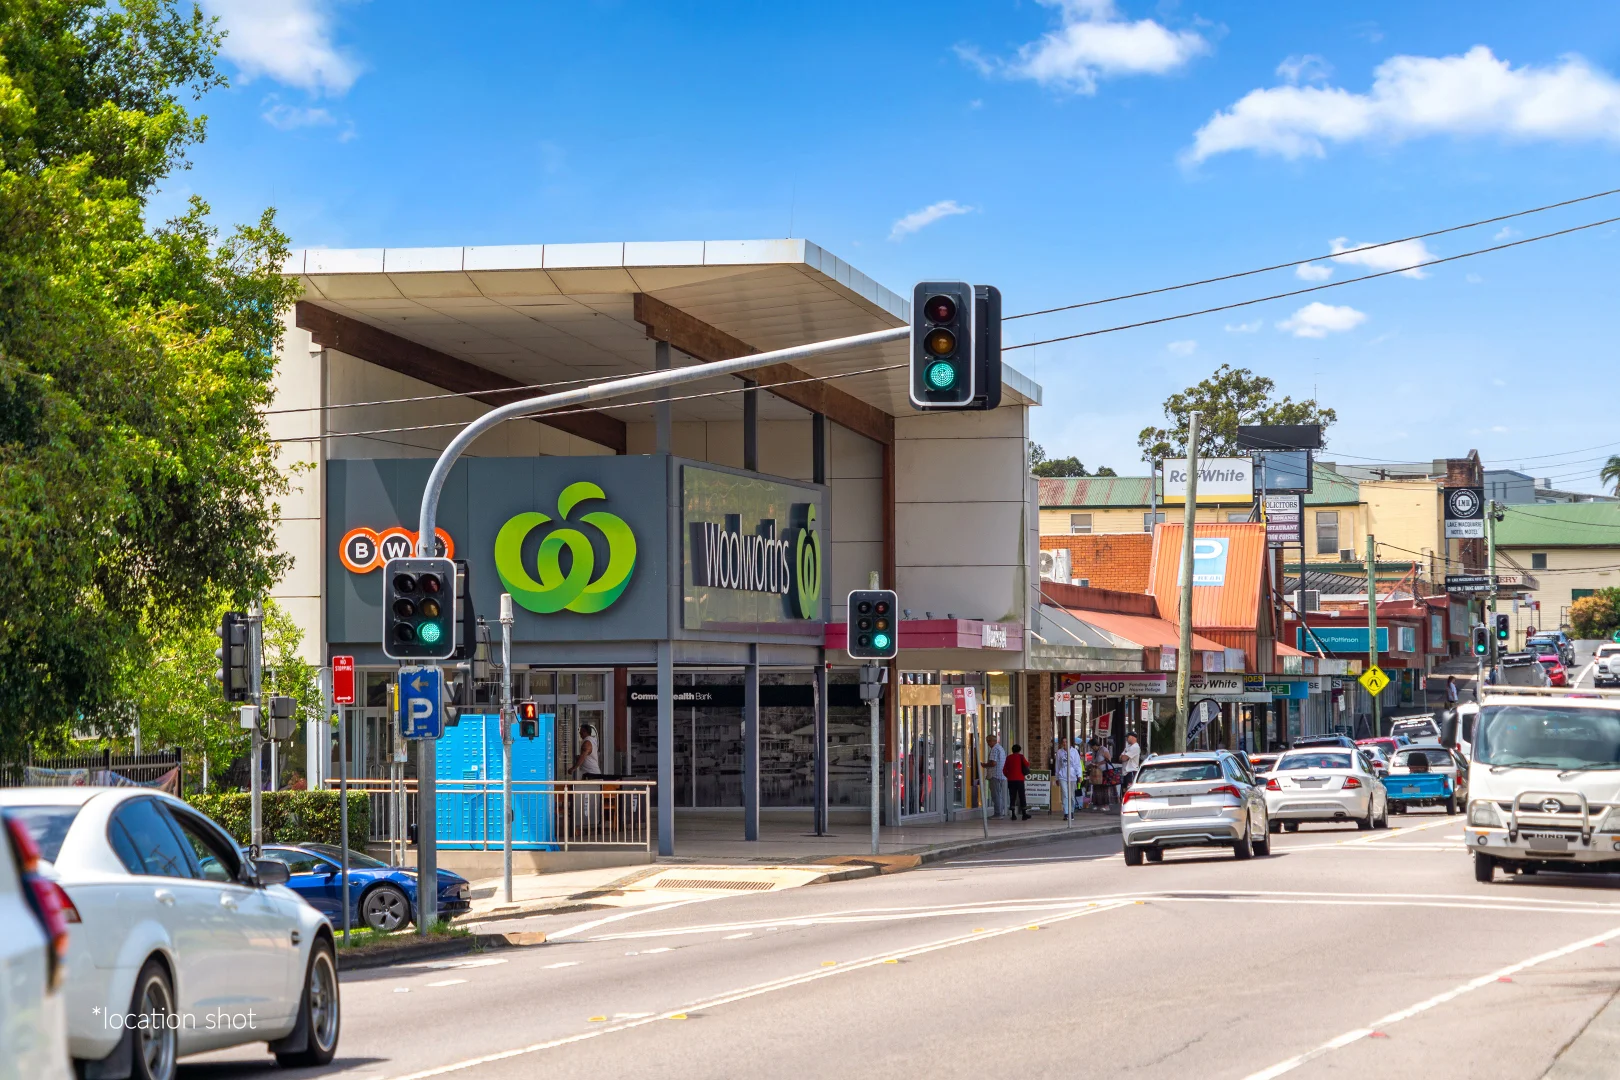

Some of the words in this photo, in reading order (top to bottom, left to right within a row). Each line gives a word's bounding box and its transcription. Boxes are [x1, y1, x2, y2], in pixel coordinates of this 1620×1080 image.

[704, 513, 790, 595] Woolworths
[631, 692, 695, 700] Commealth
[695, 692, 713, 700] Bank
[1076, 682, 1092, 692] OP
[1094, 682, 1125, 692] SHOP
[408, 698, 433, 732] P
